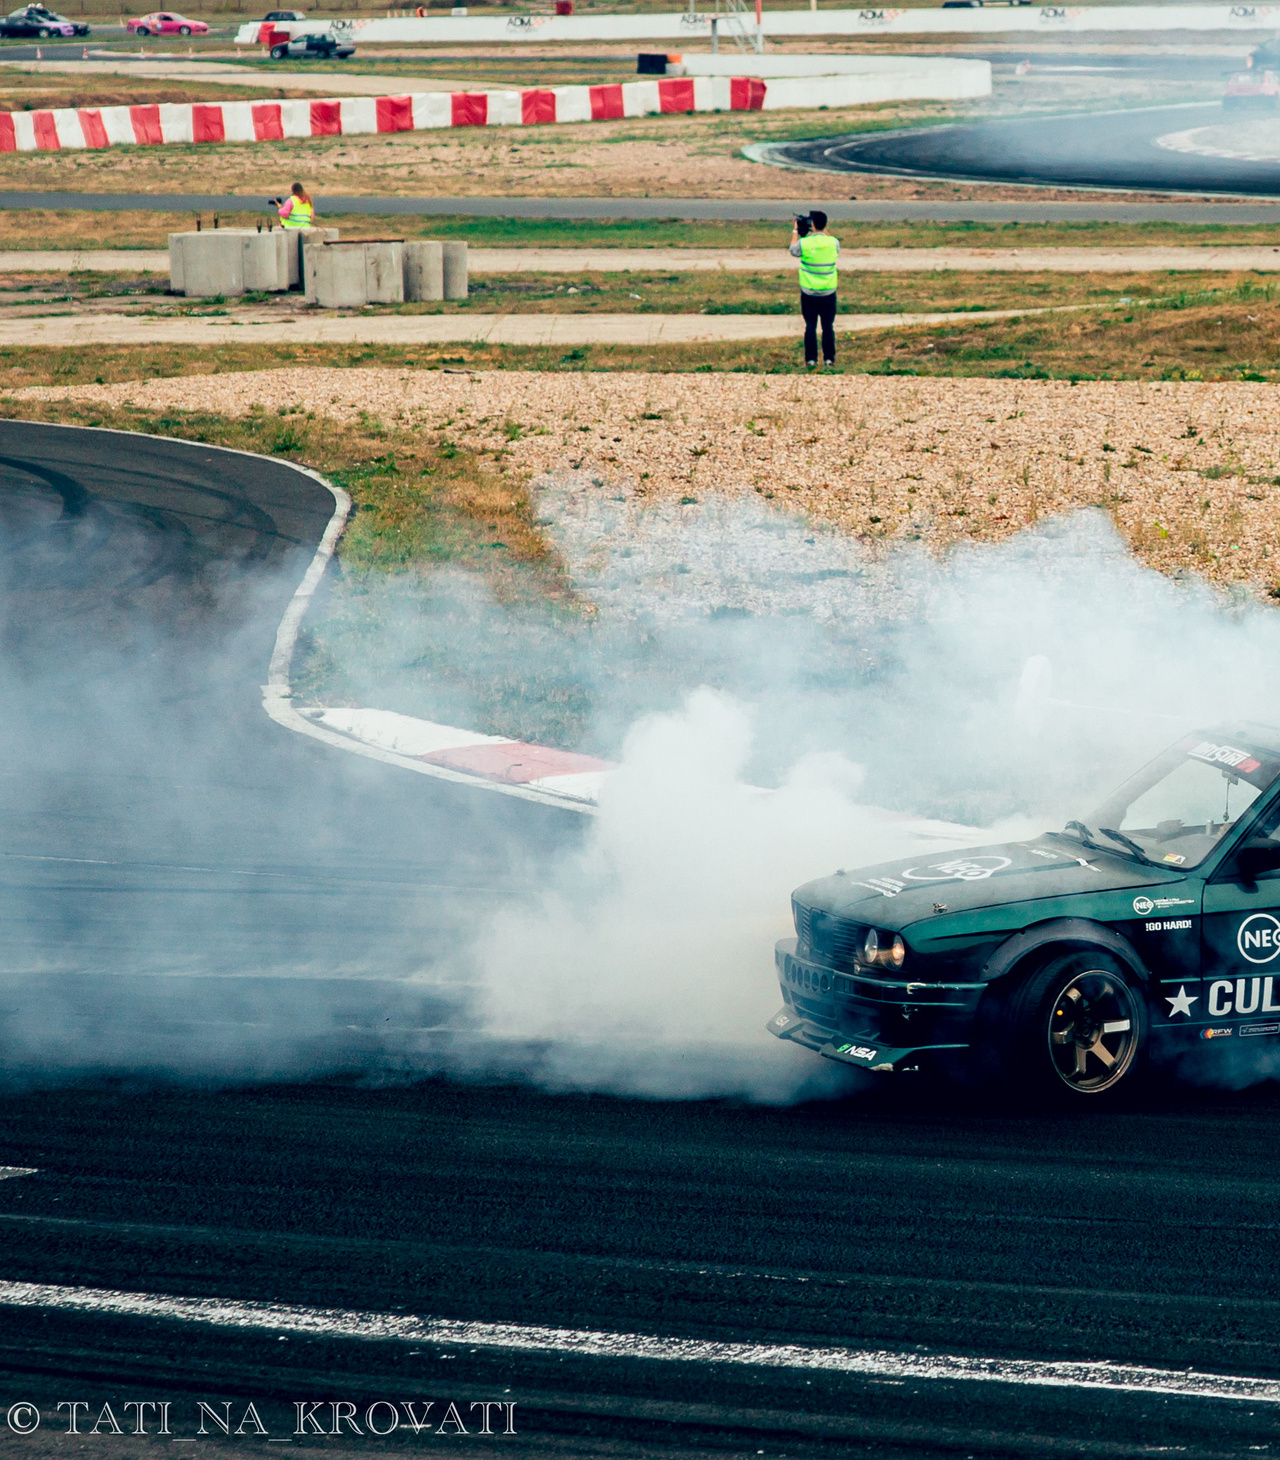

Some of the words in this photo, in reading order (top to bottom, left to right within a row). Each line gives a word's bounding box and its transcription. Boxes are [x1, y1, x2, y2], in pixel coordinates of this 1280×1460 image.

[859, 10, 884, 20] ADM
[329, 20, 353, 30] ADM
[507, 17, 531, 27] ADM
[1163, 920, 1192, 930] HARD!
[1212, 1027, 1233, 1036] RFW
[844, 1045, 878, 1061] NSA
